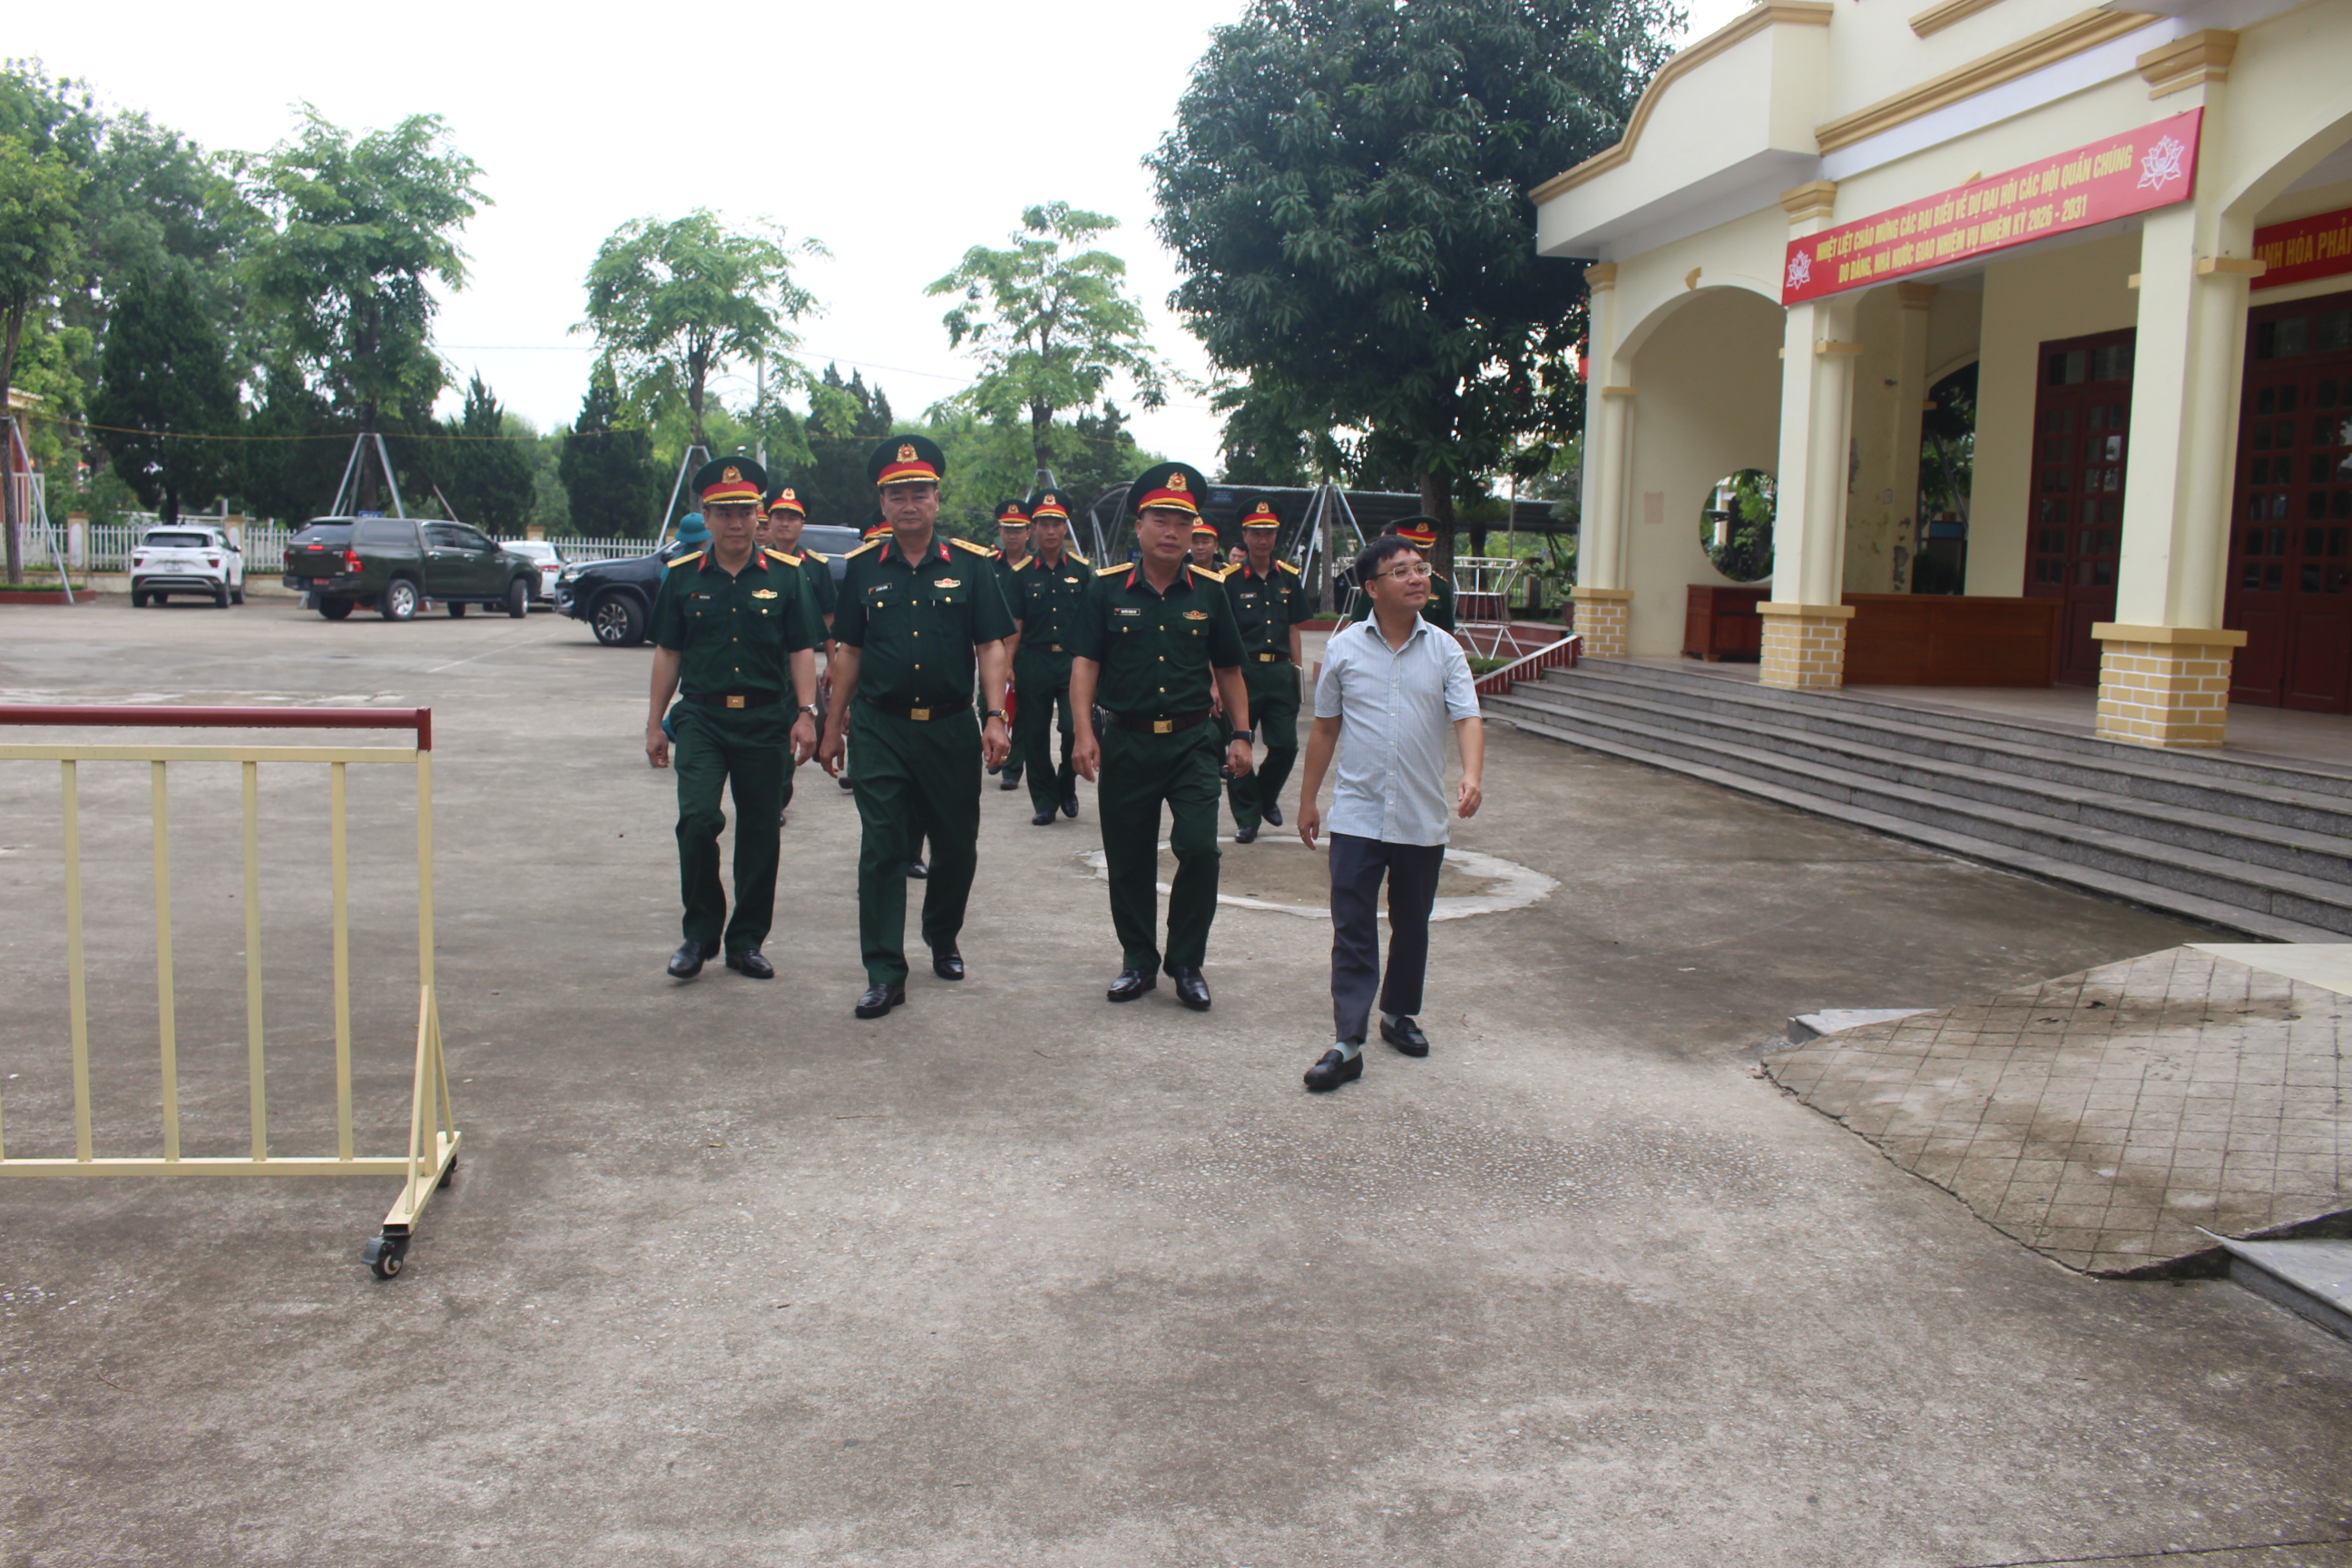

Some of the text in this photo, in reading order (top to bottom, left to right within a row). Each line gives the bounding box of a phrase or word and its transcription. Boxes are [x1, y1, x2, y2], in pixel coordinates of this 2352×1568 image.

[1817, 236, 1838, 262] NHIỆT
[1838, 230, 1853, 258] LIỆT
[1854, 224, 1874, 250] CHÀO
[1875, 219, 1898, 244] MỪNG
[1900, 211, 1916, 237] CÁC
[1917, 208, 1933, 234] ĐẠI
[1934, 194, 1955, 227] BIỂU
[1955, 191, 1967, 220] VỀ
[1967, 191, 1983, 219] DỰ
[1983, 187, 1999, 215] ĐẠI
[2000, 178, 2017, 210] HỘI
[2019, 172, 2040, 201] CÁC
[2041, 164, 2060, 197] HỘI
[2093, 144, 2133, 179] CHÚNG
[1838, 262, 1849, 283] DO
[1874, 247, 1890, 274] NHÀ
[1892, 241, 1914, 270] NƯỚC
[1916, 238, 1936, 263] GIAO
[1936, 228, 1965, 258] NHIỆM
[1966, 225, 1979, 250] VỤ
[1980, 214, 2012, 245] NHIỆM
[2013, 207, 2027, 236] KỲ
[2027, 204, 2053, 231] 2026
[2061, 193, 2088, 223] 2031
[2253, 240, 2283, 270] ANH
[2286, 230, 2314, 267] HÓA
